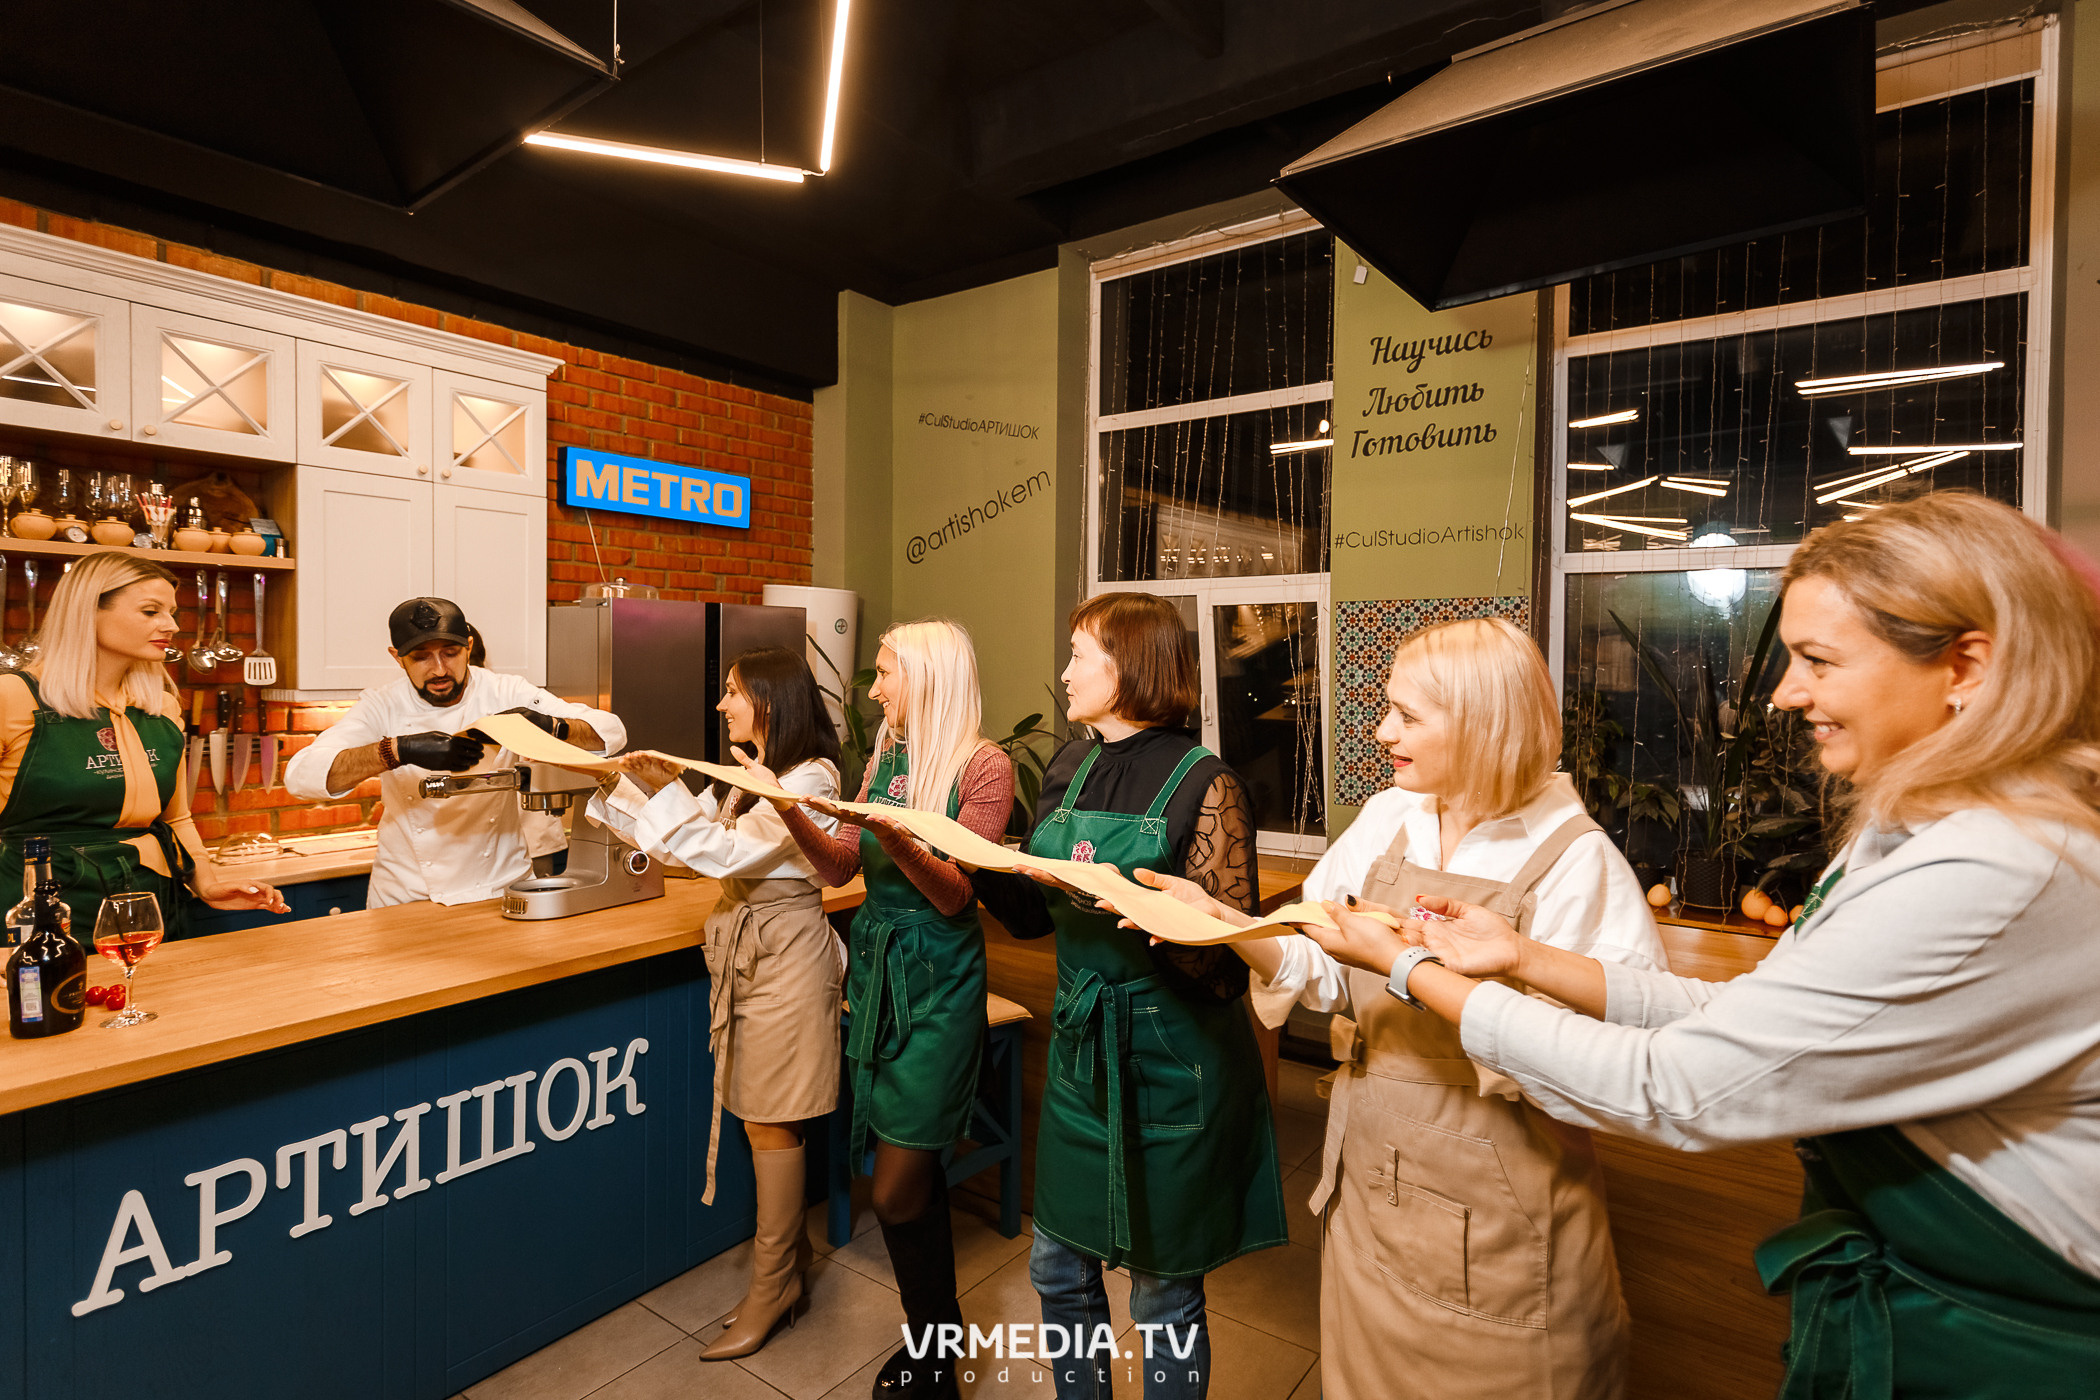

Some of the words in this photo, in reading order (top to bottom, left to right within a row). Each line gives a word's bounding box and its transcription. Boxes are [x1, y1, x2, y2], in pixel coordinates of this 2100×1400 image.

[1370, 329, 1493, 373] Научись
[1362, 382, 1484, 417] Любить
[1351, 423, 1497, 458] Готовить
[576, 459, 743, 518] METRO
[906, 470, 1051, 565] @artishokem
[1334, 523, 1524, 548] #CulStudioArtishok
[71, 1037, 649, 1317] АРТИШОК
